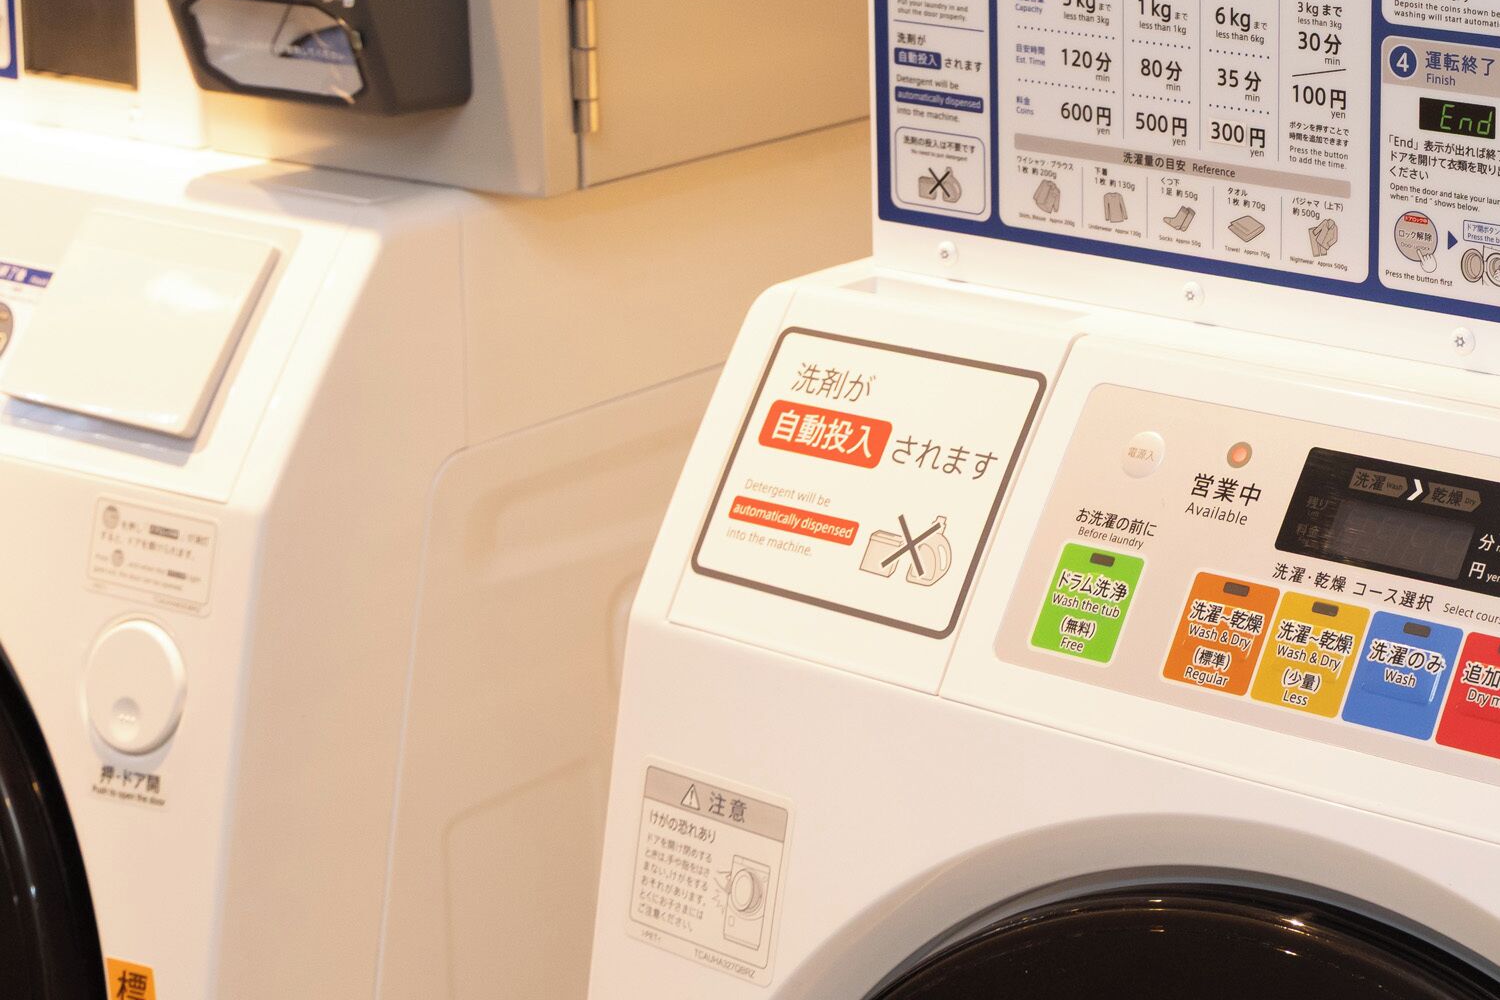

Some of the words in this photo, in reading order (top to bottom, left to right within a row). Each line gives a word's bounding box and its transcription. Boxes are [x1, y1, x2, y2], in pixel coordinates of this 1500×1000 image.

[897, 32, 926, 46] 洗剤が
[899, 51, 938, 67] 自動投入
[945, 57, 983, 72] されます
[1015, 56, 1027, 64] Est.
[1028, 57, 1045, 66] Time
[1396, 52, 1409, 72] 4
[1425, 51, 1495, 77] 運転終了
[1427, 73, 1456, 86] Finish
[1289, 121, 1350, 136] ボタンを押すことで
[1440, 104, 1493, 135] End
[1289, 132, 1349, 147] 時間を追加できます
[1123, 152, 1186, 172] 洗濯量の目安
[1192, 163, 1236, 178] Reference
[1389, 166, 1429, 181] ください
[1228, 187, 1248, 197] タオル
[1398, 230, 1432, 242] ロック解除
[791, 361, 876, 402] 洗剤が
[770, 409, 873, 460] 自動投入
[891, 435, 998, 481] されます
[744, 477, 795, 501] Detergent
[798, 488, 816, 504] will
[819, 493, 831, 507] be
[1190, 473, 1262, 507] 営業中
[1353, 471, 1383, 491] 洗濯
[1432, 487, 1463, 507] 乾燥
[733, 501, 800, 530] automatically
[800, 516, 853, 540] dispensed
[1075, 507, 1158, 537] お洗濯の前に
[1185, 502, 1248, 526] Available
[726, 527, 746, 542] into
[749, 532, 765, 546] the
[767, 537, 811, 557] machine.
[1078, 526, 1107, 542] Before
[1109, 532, 1145, 550] laundry
[1479, 534, 1495, 551] 分
[1469, 562, 1486, 580] 円
[1058, 570, 1127, 602] ドラム洗浄
[1052, 593, 1079, 608] Wash
[1081, 599, 1099, 612] the
[1101, 604, 1120, 618] tub
[1353, 581, 1434, 612] コース選択
[1444, 603, 1473, 618] Select
[1060, 637, 1084, 652] Free
[1188, 624, 1218, 641] Wash
[1220, 632, 1228, 644] &
[1230, 634, 1251, 650] Dry
[1277, 645, 1306, 662] Wash
[1309, 653, 1318, 664] &
[1321, 654, 1341, 671] Dry
[1369, 641, 1445, 674] 洗濯のみ
[1184, 667, 1229, 687] Regular
[1384, 669, 1416, 687] Wash
[1283, 690, 1308, 706] Less
[1467, 688, 1488, 705] Dry
[708, 791, 748, 824] 注意
